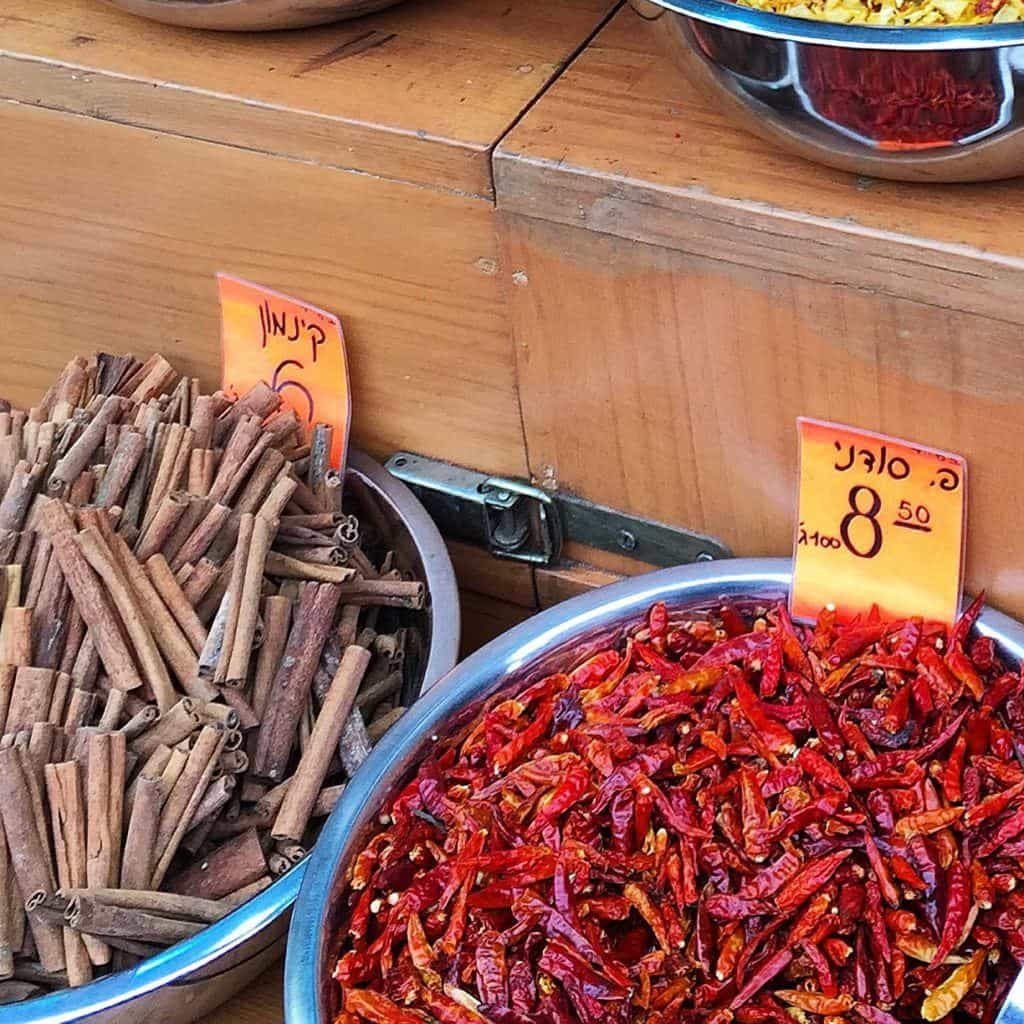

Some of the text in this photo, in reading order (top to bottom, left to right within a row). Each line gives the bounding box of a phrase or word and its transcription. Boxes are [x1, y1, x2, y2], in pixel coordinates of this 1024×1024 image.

[258, 299, 326, 363] קינמון
[833, 440, 911, 481] סודני
[839, 484, 931, 560] 8 50
